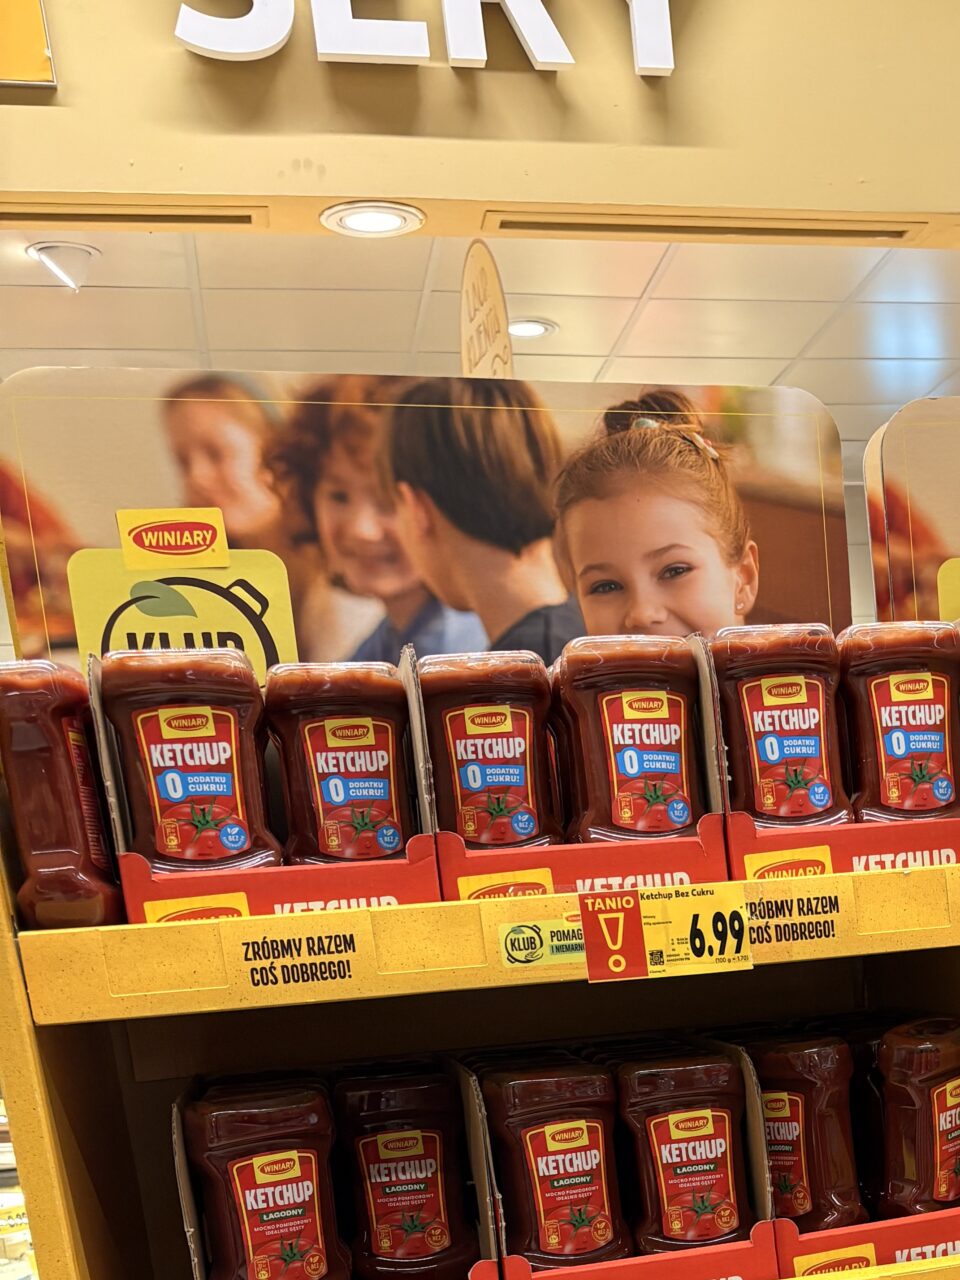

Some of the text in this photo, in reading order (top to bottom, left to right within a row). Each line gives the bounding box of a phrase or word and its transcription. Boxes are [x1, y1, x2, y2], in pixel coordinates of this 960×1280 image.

[142, 530, 212, 547] WINIARY
[771, 684, 800, 696] WINIARY
[632, 700, 662, 709] WINIARY
[170, 715, 208, 729] WINIARY
[752, 707, 819, 731] KETCHUP
[880, 704, 944, 727] KETCHUP
[335, 726, 368, 738] WINIARY
[612, 723, 681, 745] KETCHUP
[150, 741, 232, 767] KETCHUP
[456, 737, 526, 760] KETCHUP
[316, 750, 389, 774] KETCHUP
[623, 749, 638, 774] 0
[643, 761, 675, 770] CUKRU!
[166, 774, 184, 799] 0
[187, 775, 226, 784] DODATKU
[348, 781, 384, 789] DODATKU
[188, 784, 227, 793] CUKRU!
[328, 779, 344, 803] 0
[349, 789, 384, 797] CUKRU!
[640, 888, 714, 901] Ketchup Bez Cukru
[585, 896, 634, 912] TANIO
[689, 910, 744, 957] 6.99
[242, 937, 303, 962] ZRÓBMY
[510, 936, 537, 952] KLUB
[250, 963, 279, 987] COŚ
[661, 1139, 726, 1164] KETCHUP
[264, 1161, 294, 1173] WINIARY
[369, 1158, 436, 1183] KETCHUP
[676, 1163, 715, 1173] ŁAGODNY
[245, 1180, 313, 1210] KETCHUP
[385, 1184, 425, 1193] ŁAGODNY
[263, 1208, 303, 1220] ŁAGODNY
